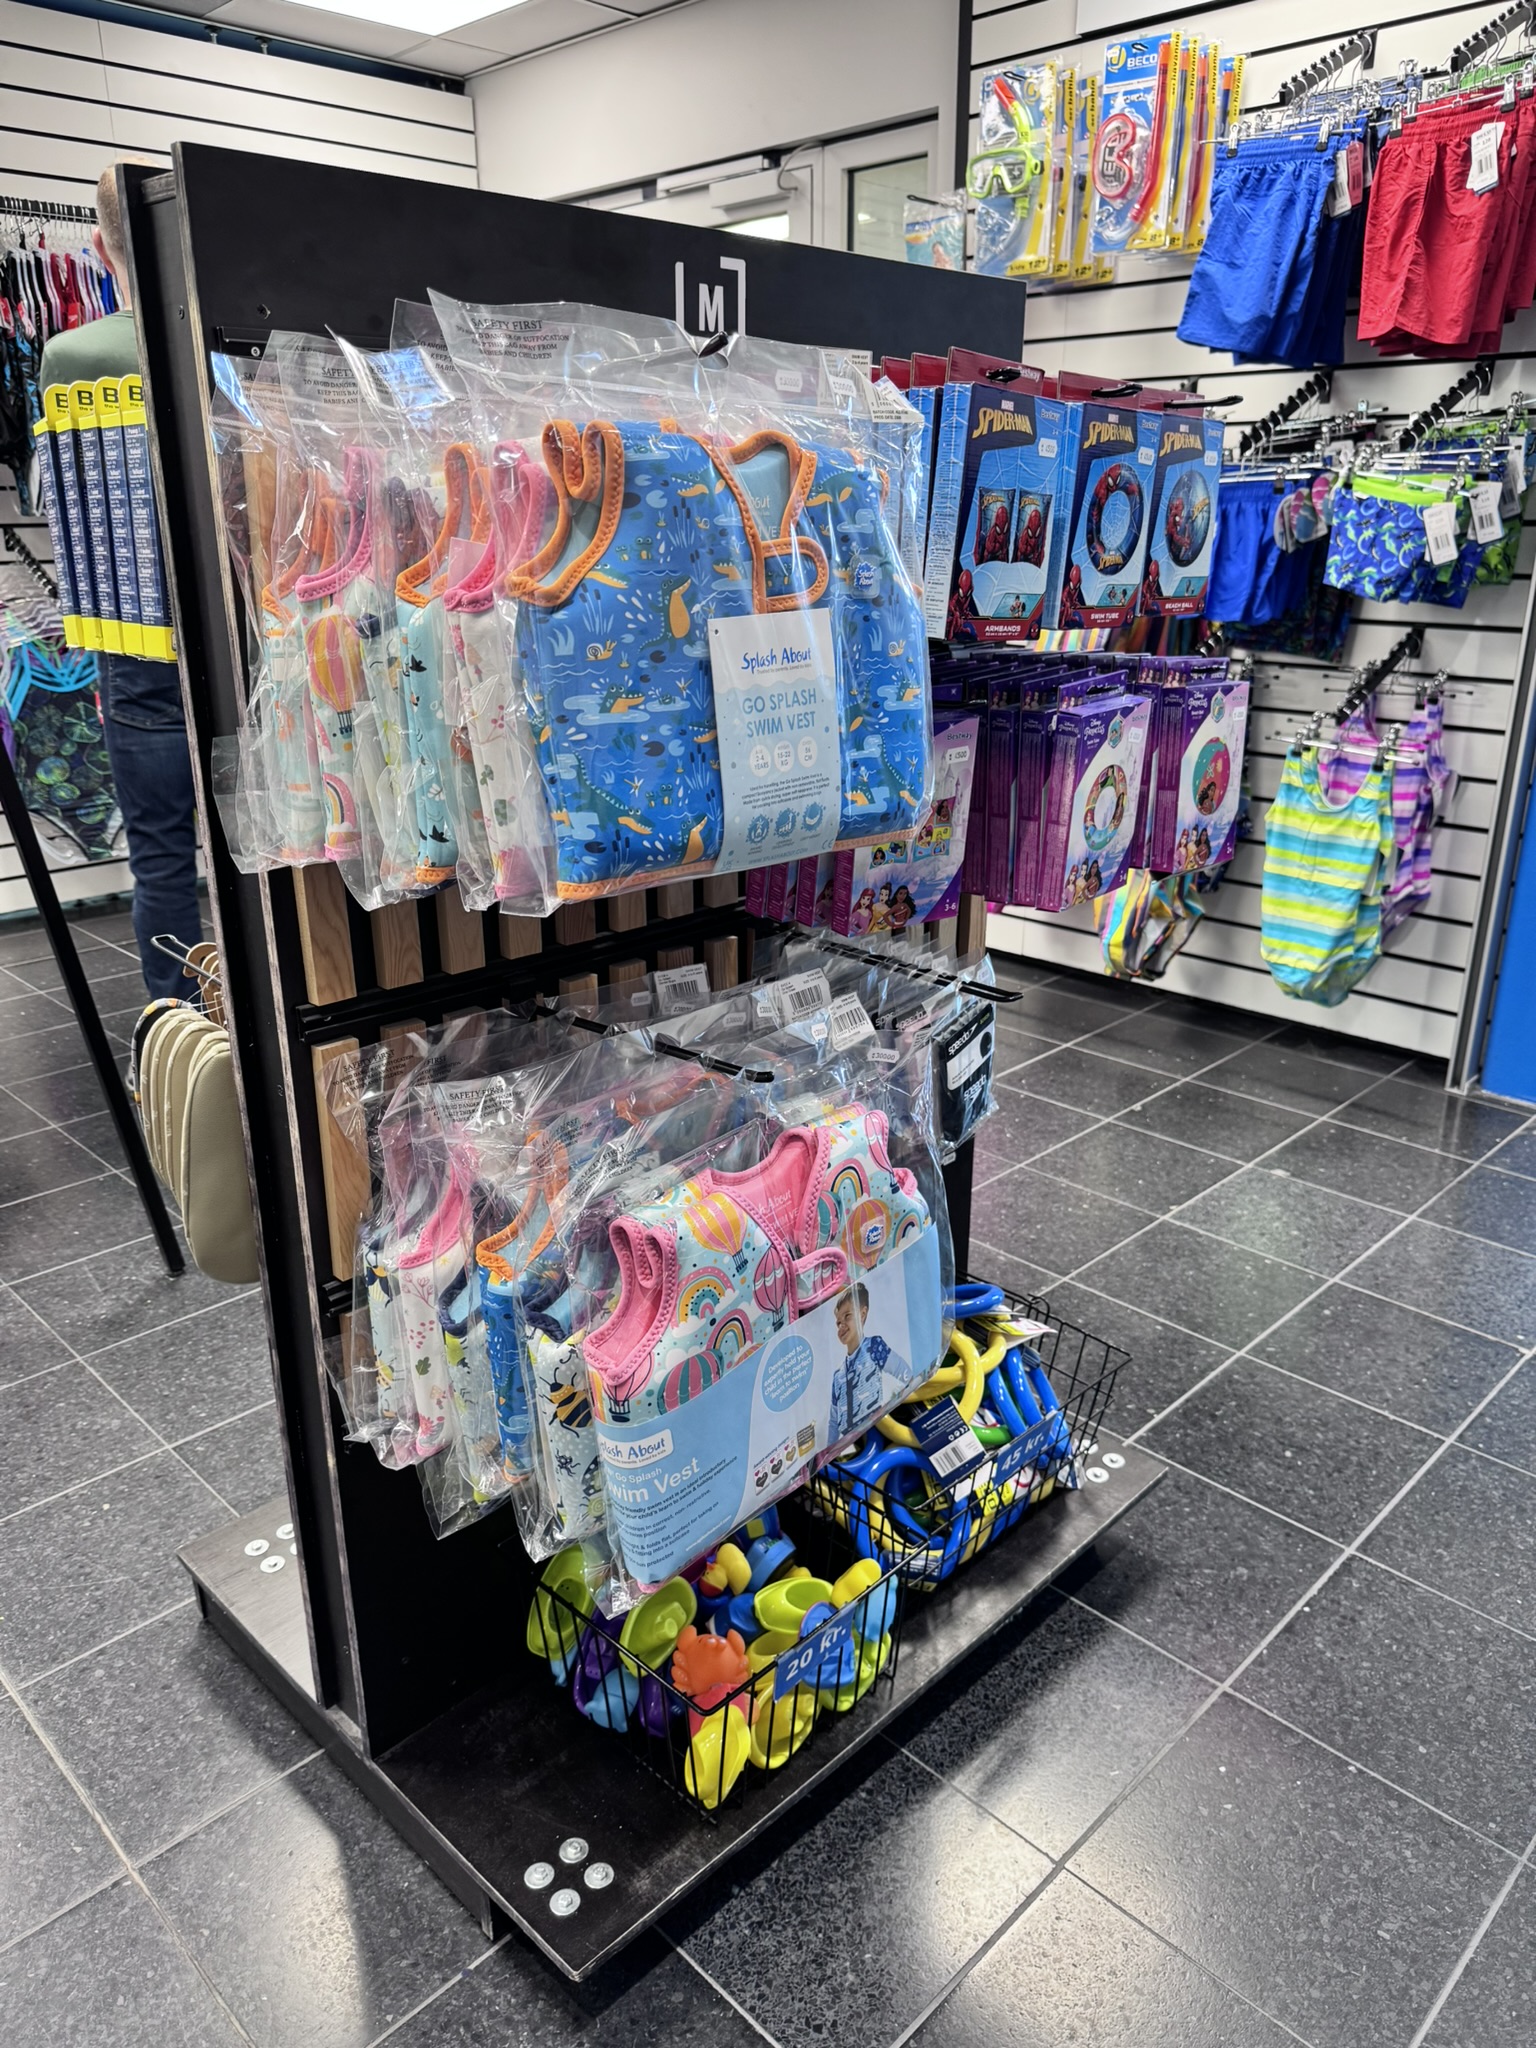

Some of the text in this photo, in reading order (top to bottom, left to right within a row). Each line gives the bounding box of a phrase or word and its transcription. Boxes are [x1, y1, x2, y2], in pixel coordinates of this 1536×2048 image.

[1127, 53, 1157, 67] BECO
[471, 318, 543, 330] SAFETY FIRST
[523, 334, 569, 342] SUFFOCATION
[518, 351, 552, 359] CHILDREN
[321, 367, 355, 377] SAFETY
[972, 407, 1033, 438] SPIDER-MAN
[1083, 421, 1135, 449] SPIDER-MAN
[1159, 432, 1202, 457] SPIDER-MAN
[741, 647, 811, 675] Splash About
[742, 688, 817, 714] GO SPLASH
[747, 711, 816, 738] SWIM VEST
[754, 762, 769, 770] YEARS
[944, 903, 956, 911] 3-6
[948, 1032, 970, 1056] speedo
[449, 1091, 480, 1100] SAFETY
[963, 1074, 987, 1102] speedo
[768, 1348, 796, 1374] Developed
[780, 1383, 800, 1403] position
[628, 1438, 665, 1460] About
[1001, 1433, 1044, 1471] 45 kr.
[608, 1457, 700, 1503] wim Vest
[615, 1467, 662, 1484] Go Splash
[786, 1626, 846, 1681] 20 kr.
